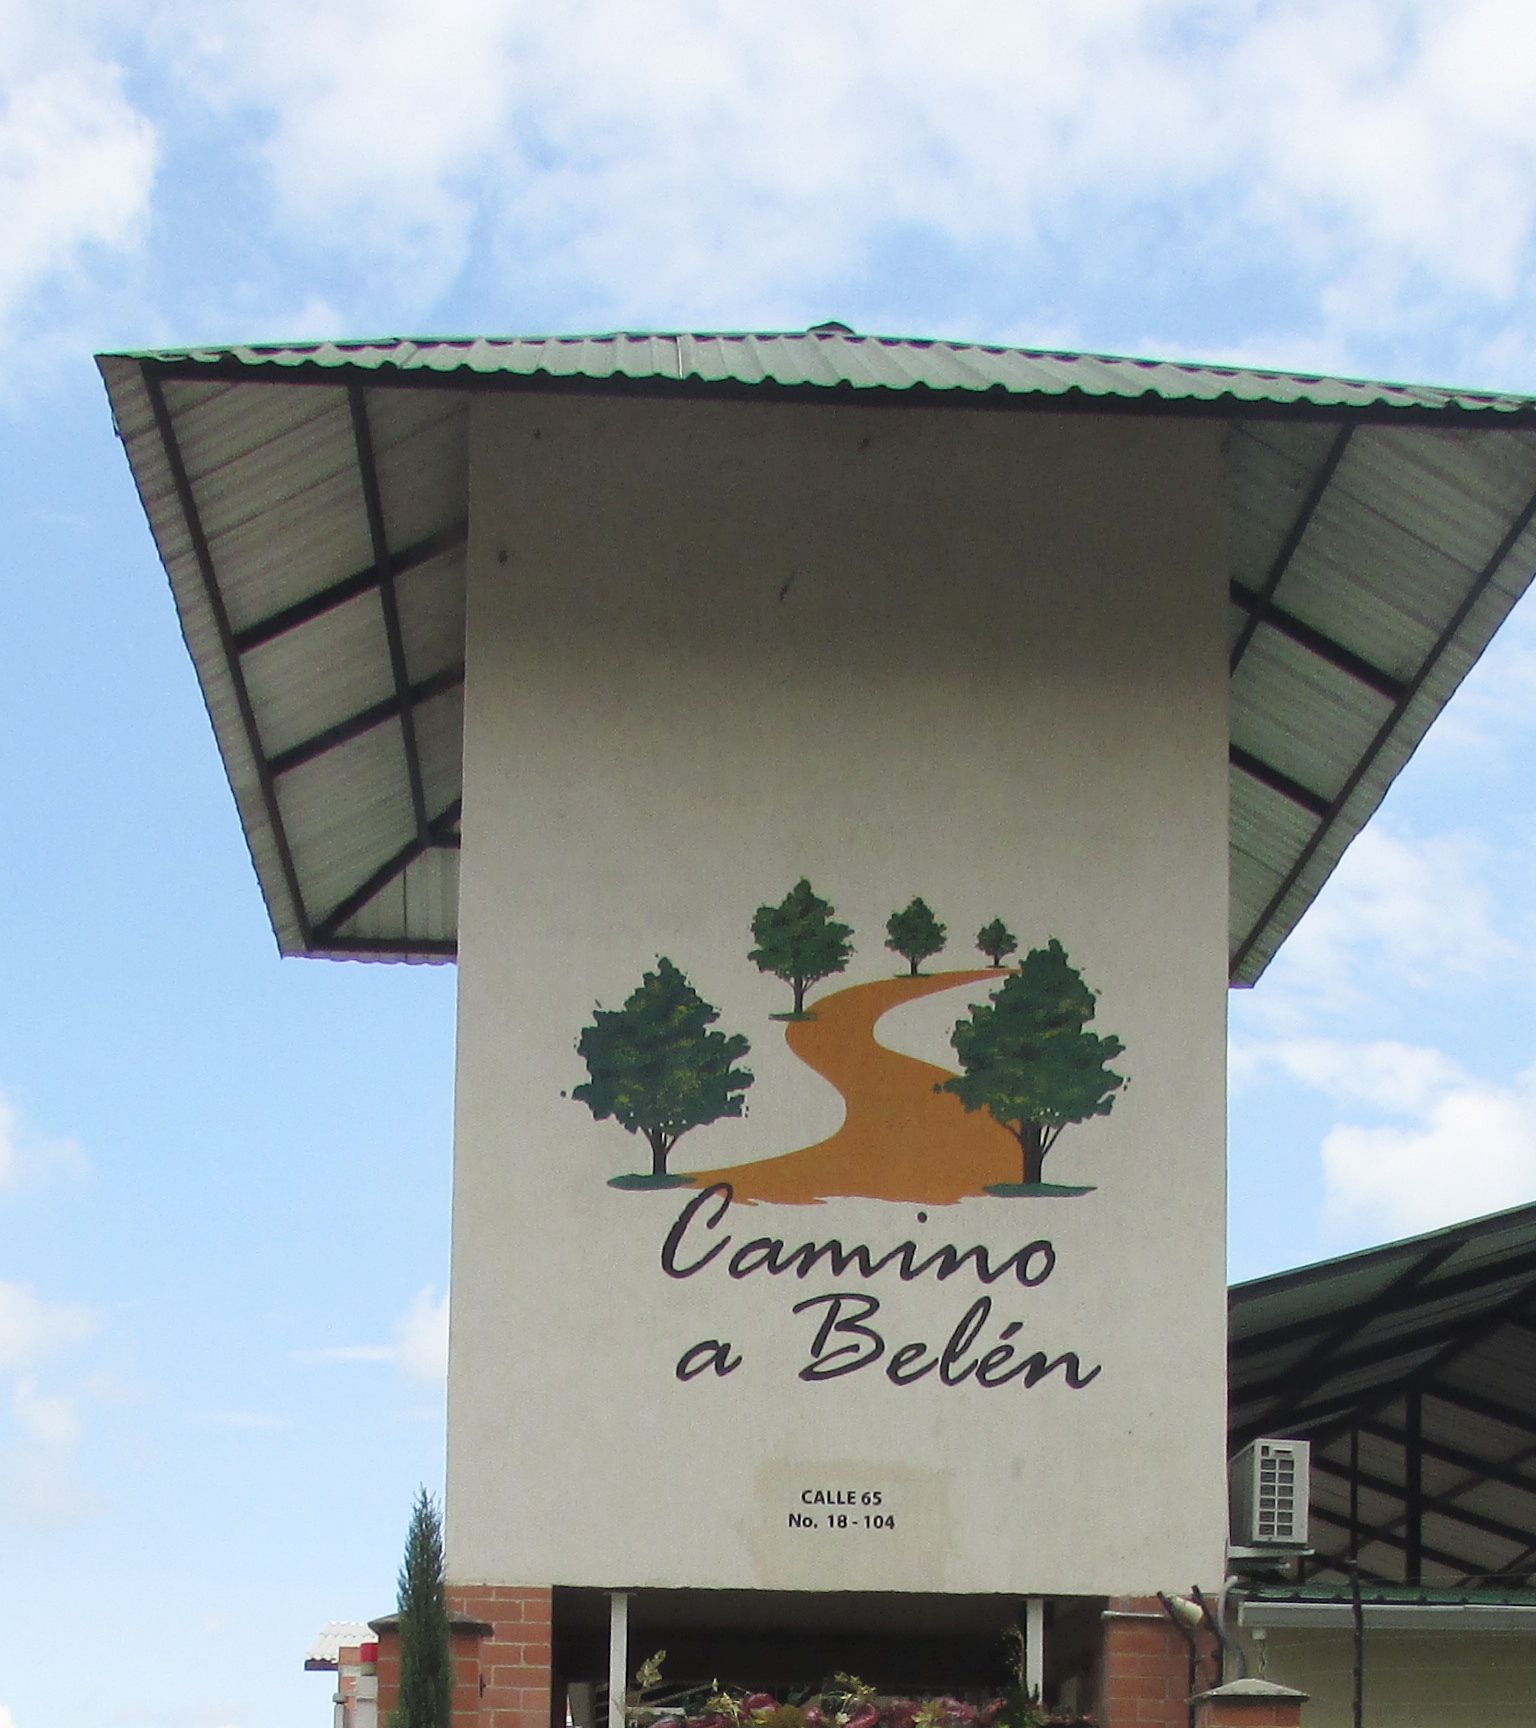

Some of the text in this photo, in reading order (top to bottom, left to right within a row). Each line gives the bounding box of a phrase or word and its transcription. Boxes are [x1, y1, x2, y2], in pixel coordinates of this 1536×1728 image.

[661, 1181, 1057, 1288] Camino
[675, 1292, 1103, 1389] a Belén
[788, 1513, 818, 1529] No.
[827, 1514, 848, 1529] 18
[863, 1514, 896, 1530] 104
[801, 1490, 883, 1506] CALLE 65
